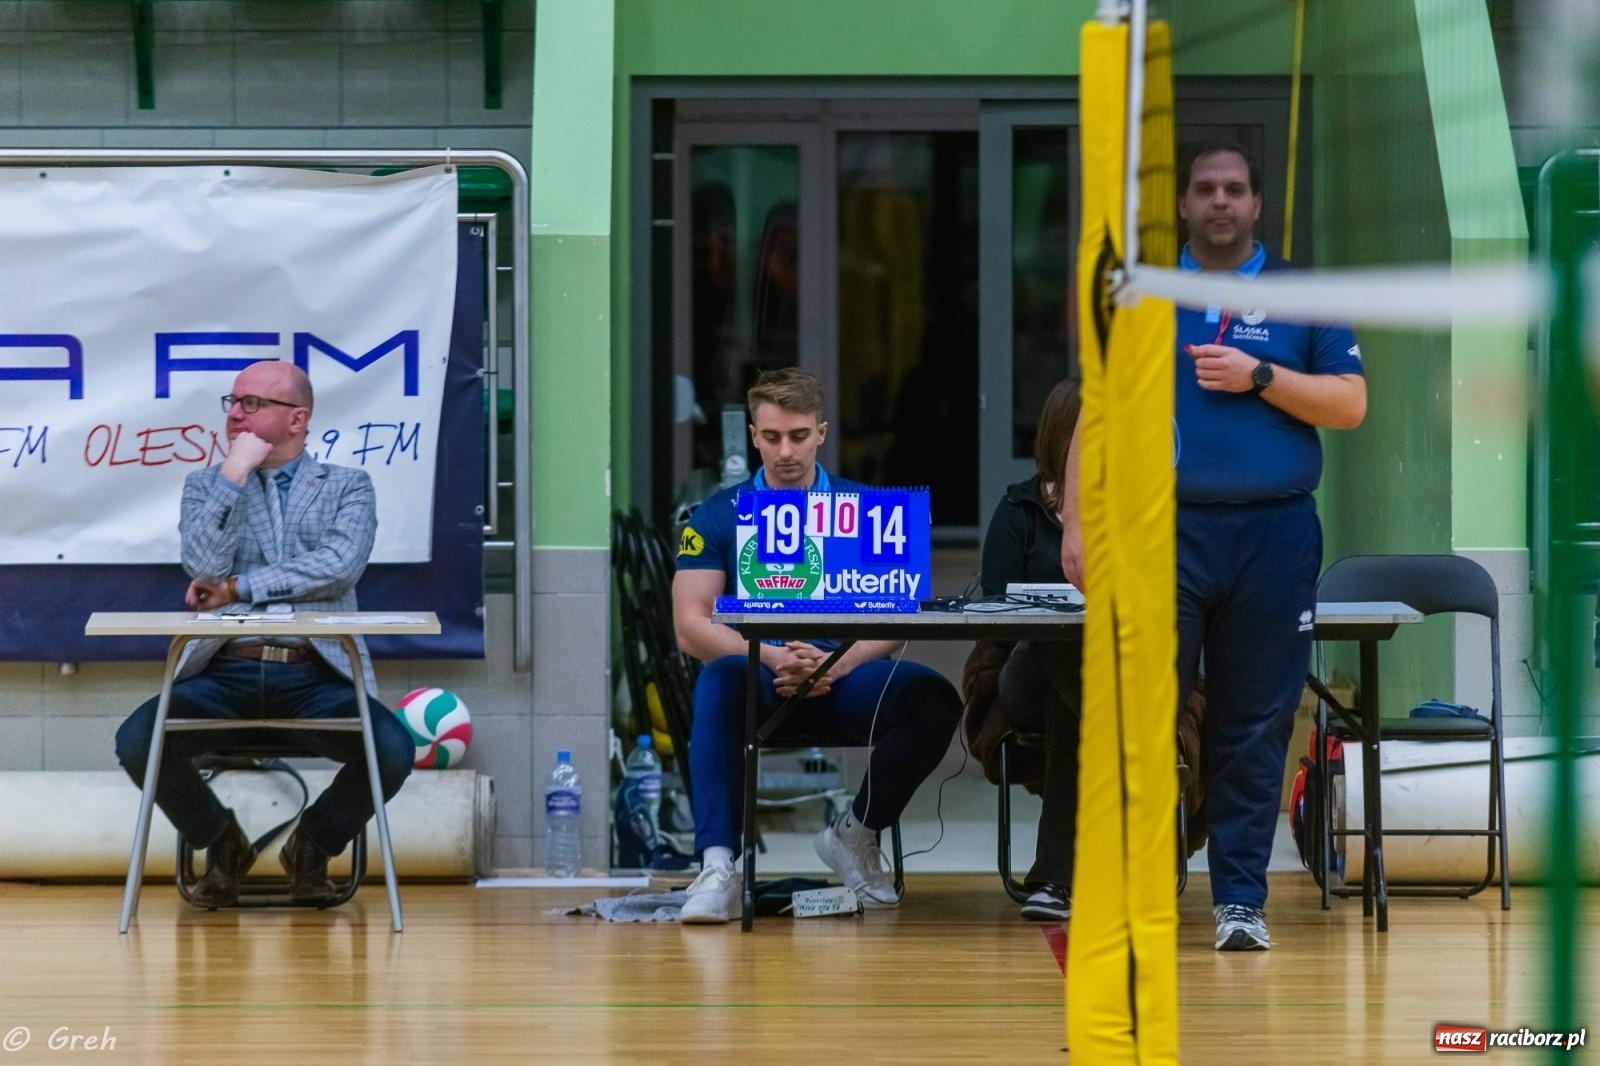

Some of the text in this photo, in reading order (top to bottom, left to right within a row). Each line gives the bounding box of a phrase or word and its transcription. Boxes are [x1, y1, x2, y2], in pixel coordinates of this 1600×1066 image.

[155, 329, 419, 399] FM
[84, 424, 228, 467] OLESN
[352, 422, 421, 465] FM
[761, 503, 800, 555] 19
[813, 502, 855, 534] 1 0
[867, 505, 906, 555] 14
[740, 538, 820, 575] KLUB RSKI
[822, 568, 921, 600] utterfly
